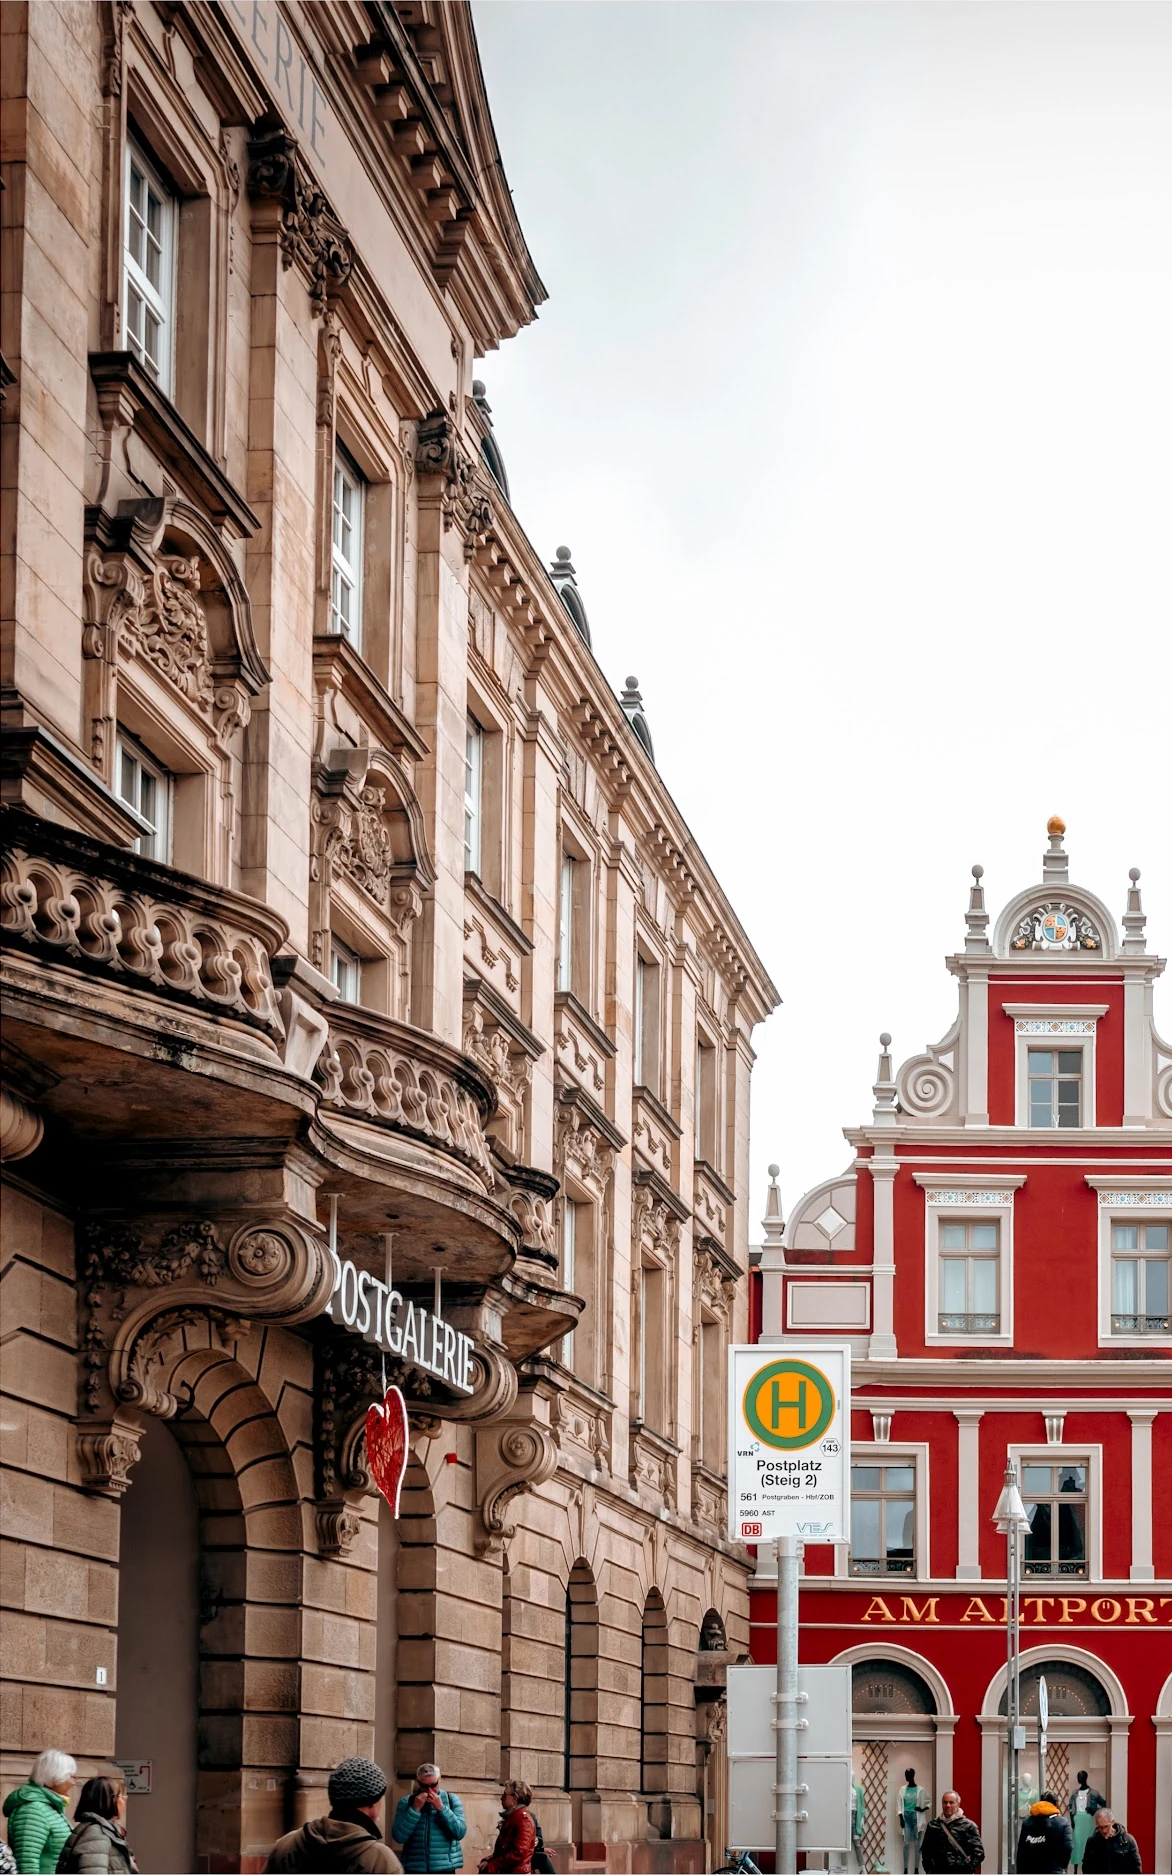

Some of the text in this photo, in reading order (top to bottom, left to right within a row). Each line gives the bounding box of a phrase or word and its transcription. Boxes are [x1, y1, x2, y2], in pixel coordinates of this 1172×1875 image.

[230, 1, 327, 169] ERIE
[771, 1381, 807, 1429] H
[822, 1444, 839, 1452] 143
[757, 1460, 822, 1473] Postplatz
[761, 1474, 817, 1488] (Steig 2)
[740, 1493, 757, 1501] 561
[744, 1524, 760, 1535] DB
[861, 1597, 940, 1622] AM
